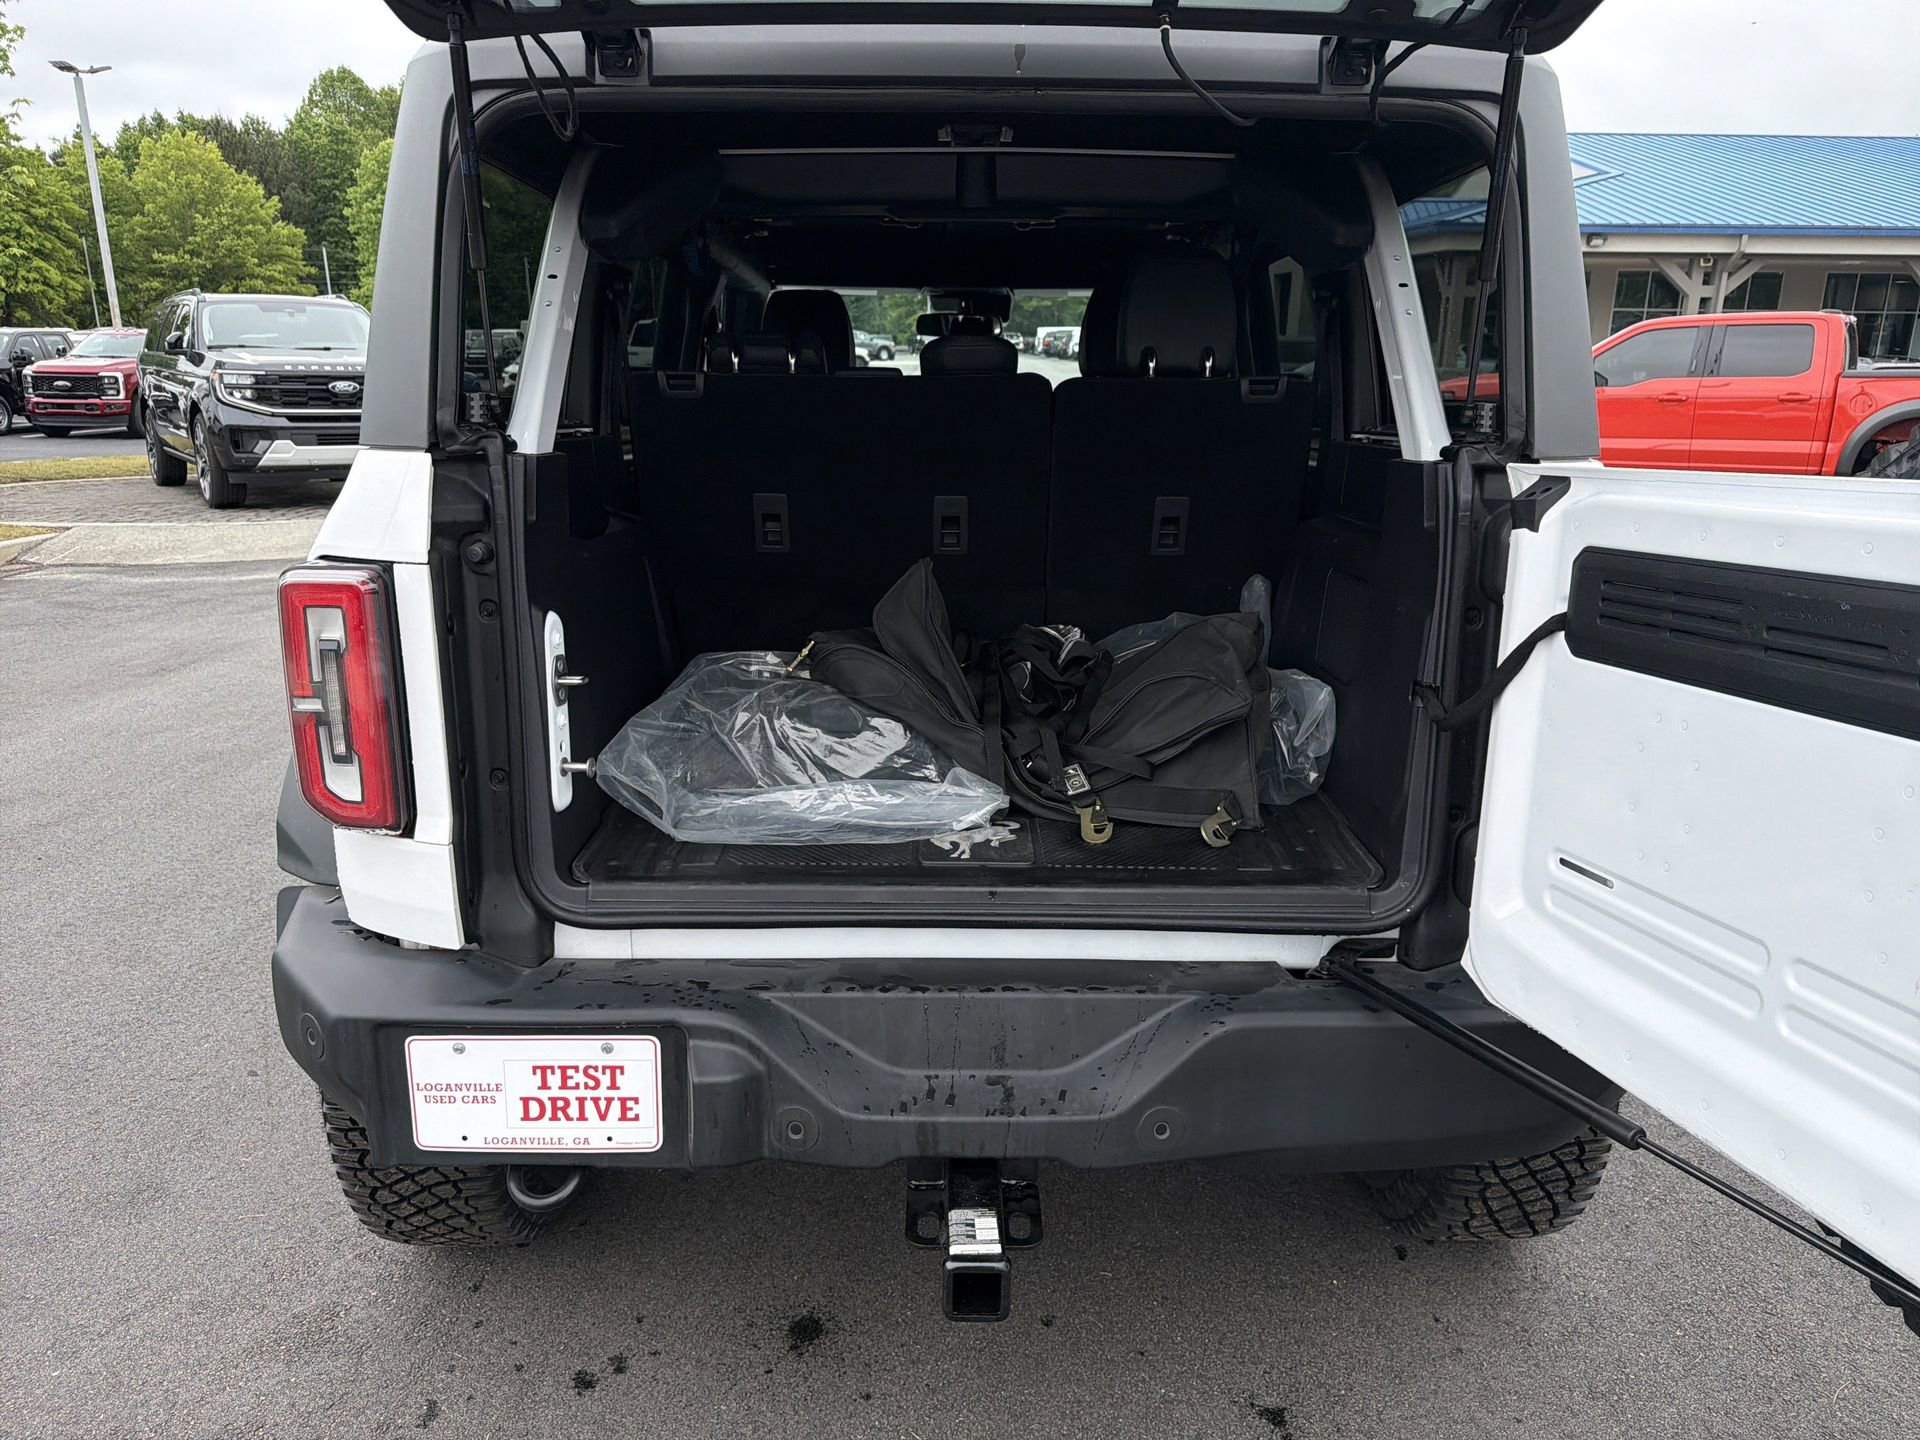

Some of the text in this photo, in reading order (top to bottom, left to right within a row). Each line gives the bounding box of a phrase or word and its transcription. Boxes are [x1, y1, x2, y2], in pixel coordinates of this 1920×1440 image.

[532, 1065, 624, 1090] TEST
[416, 1083, 502, 1092] LOGANVILLE
[424, 1095, 496, 1104] USED CARS
[519, 1096, 640, 1122] DRIVE
[484, 1137, 590, 1146] LOGANVILLE, GA
